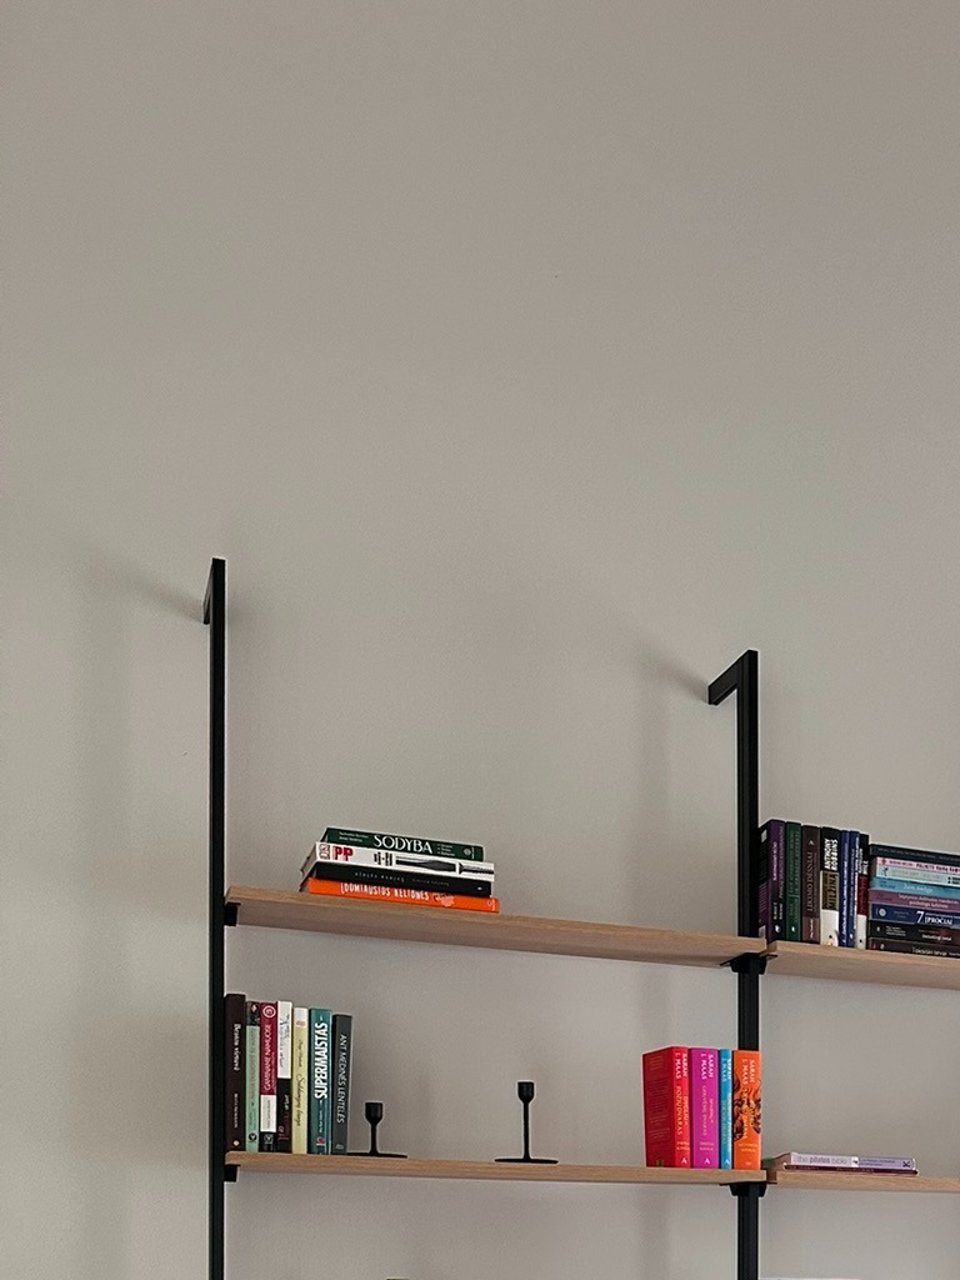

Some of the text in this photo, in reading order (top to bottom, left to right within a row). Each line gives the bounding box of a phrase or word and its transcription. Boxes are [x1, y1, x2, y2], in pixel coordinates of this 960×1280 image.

[373, 834, 433, 854] SODYBA
[332, 845, 354, 862] PP
[915, 911, 925, 924] 7
[338, 1034, 348, 1049] ANT
[313, 1022, 328, 1099] SUPERMAISTAS
